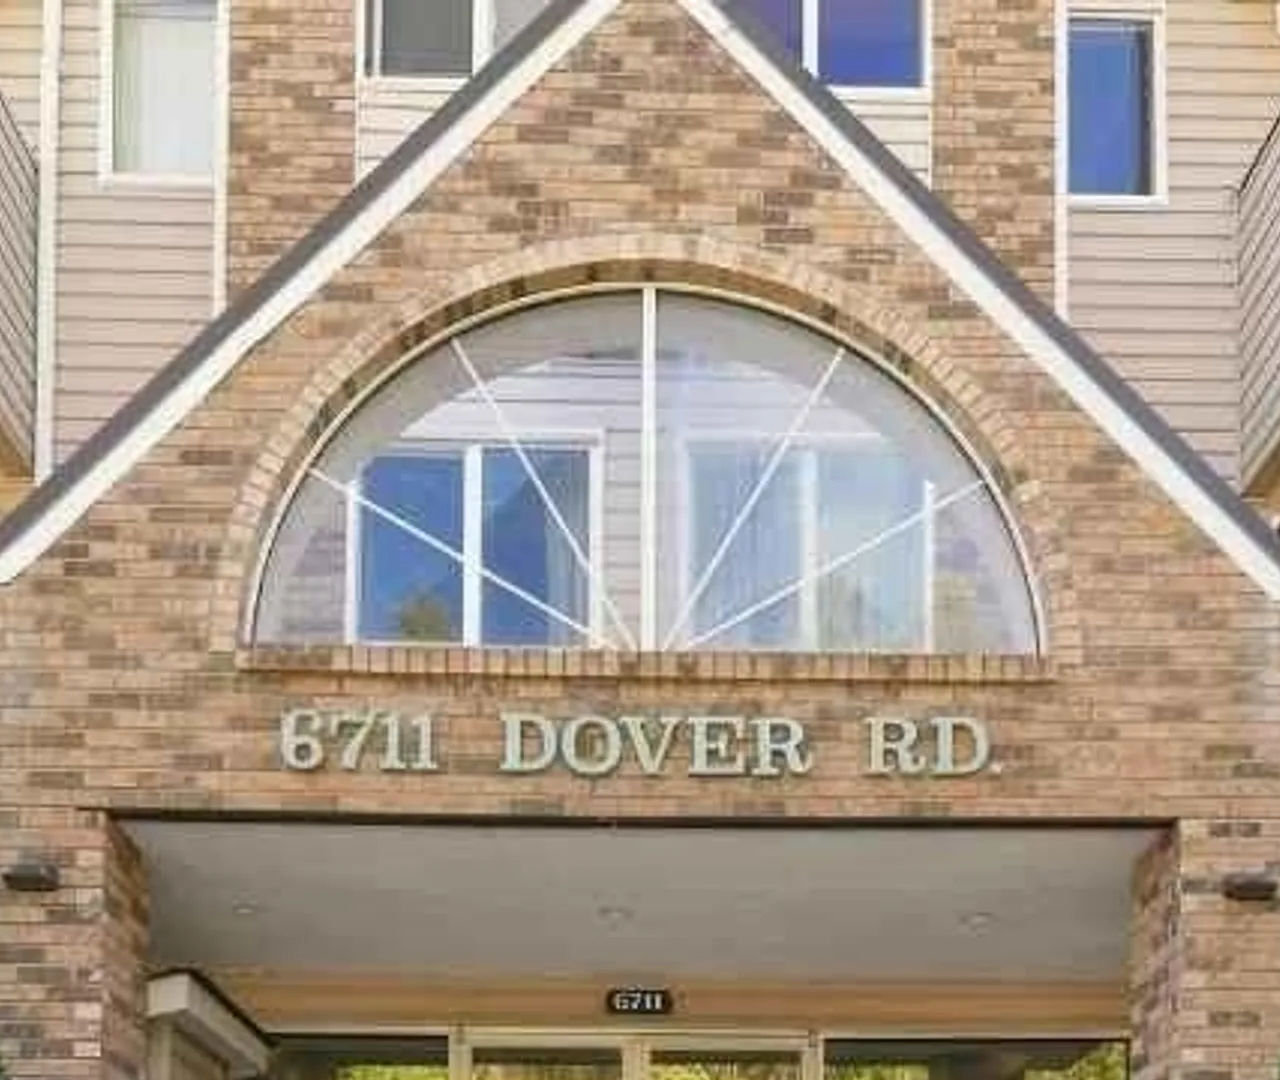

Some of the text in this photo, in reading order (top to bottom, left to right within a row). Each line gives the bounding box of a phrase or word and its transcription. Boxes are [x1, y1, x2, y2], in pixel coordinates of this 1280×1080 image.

[278, 707, 1005, 779] 6711 DOVER RD.
[614, 991, 662, 1010] 6711
